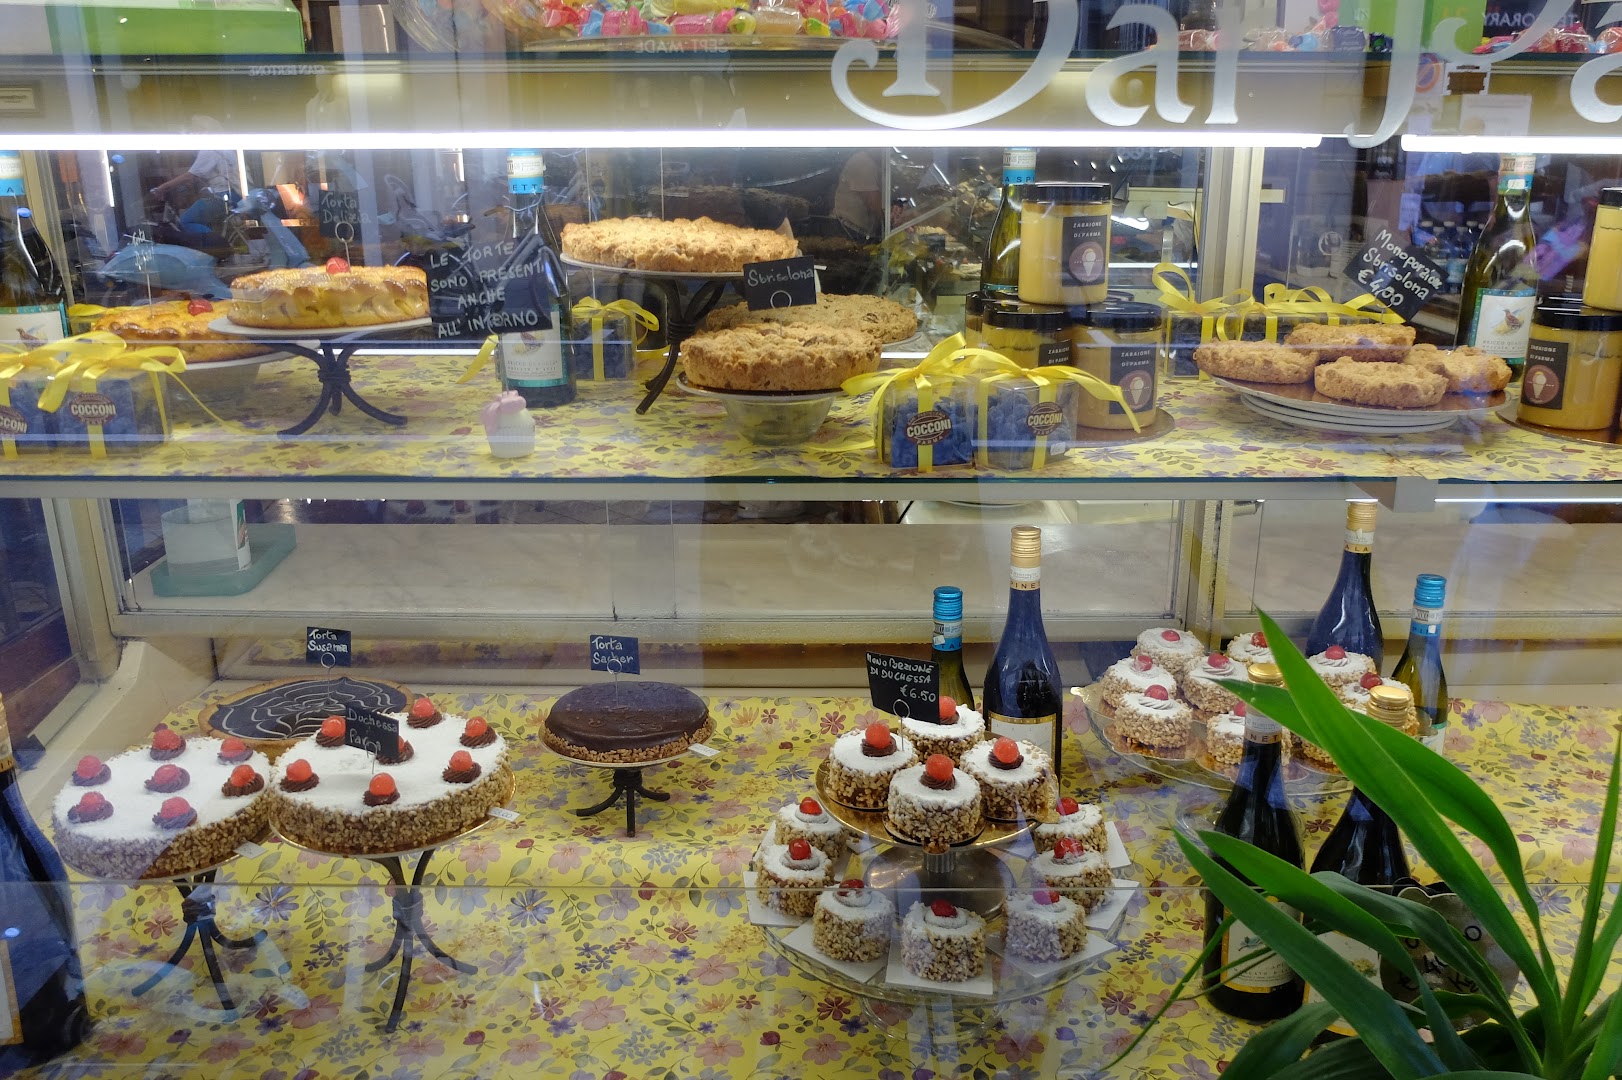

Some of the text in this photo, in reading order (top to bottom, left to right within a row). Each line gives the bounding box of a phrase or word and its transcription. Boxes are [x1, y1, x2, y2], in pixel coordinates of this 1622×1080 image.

[321, 191, 357, 209] Torta
[430, 241, 515, 269] LE TORTE
[430, 257, 545, 293] SONO PRESENTI
[747, 265, 815, 288] Sbrisolona
[1363, 247, 1430, 301] Sbrisolona
[457, 286, 506, 311] ANCHE
[70, 404, 117, 416] COCCONI
[1027, 412, 1063, 427] COCCONI
[906, 418, 952, 438] COCCONI
[308, 628, 338, 641] Torta
[591, 636, 623, 650] Torta
[869, 666, 932, 684] DI DUCHESSA
[347, 707, 398, 732] Duchessa
